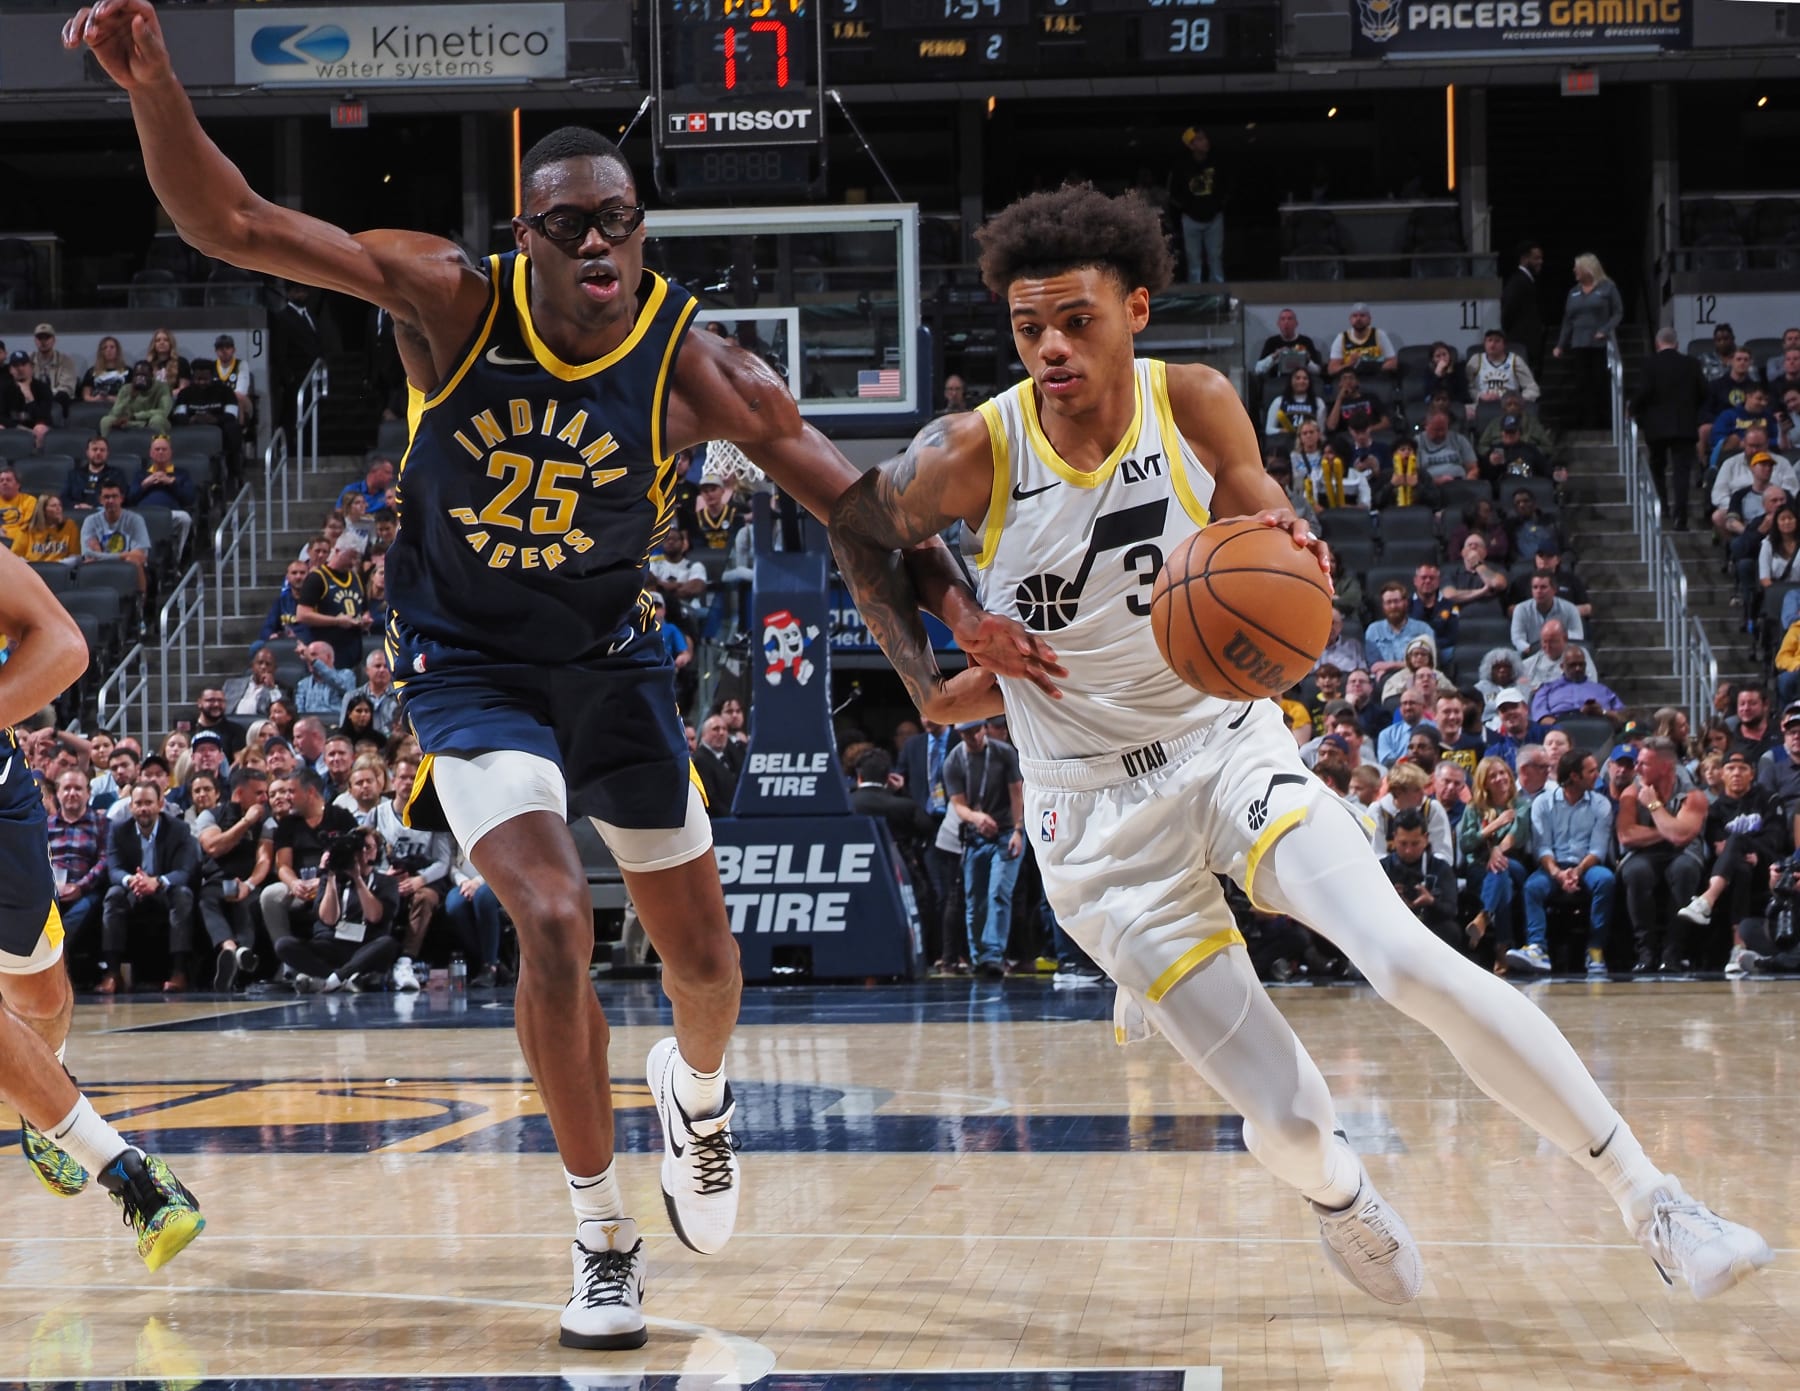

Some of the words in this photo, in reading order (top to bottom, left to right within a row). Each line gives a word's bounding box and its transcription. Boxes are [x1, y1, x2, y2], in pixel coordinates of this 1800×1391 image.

[1408, 2, 1541, 30] PACERS
[1549, 0, 1681, 26] GAMING
[372, 23, 549, 58] Kinetico
[986, 34, 1003, 60] 2
[1169, 18, 1211, 52] 38
[316, 64, 384, 79] water
[395, 59, 495, 80] systems
[723, 20, 789, 90] 17
[337, 103, 363, 124] EXIT
[708, 109, 812, 131] TISSOT
[1460, 301, 1481, 330] 11
[1696, 295, 1717, 325] 12
[252, 329, 263, 358] 9
[453, 398, 628, 488] INDIANA
[1121, 453, 1162, 484] LVT
[479, 450, 586, 535] 25
[448, 507, 595, 570] PACERS
[1123, 543, 1164, 617] 3
[343, 598, 356, 617] 0
[749, 753, 829, 774] BELLE
[1121, 740, 1168, 777] UTAH
[757, 776, 818, 796] TIRE
[713, 843, 876, 885] BELLE
[724, 892, 851, 933] TIRE
